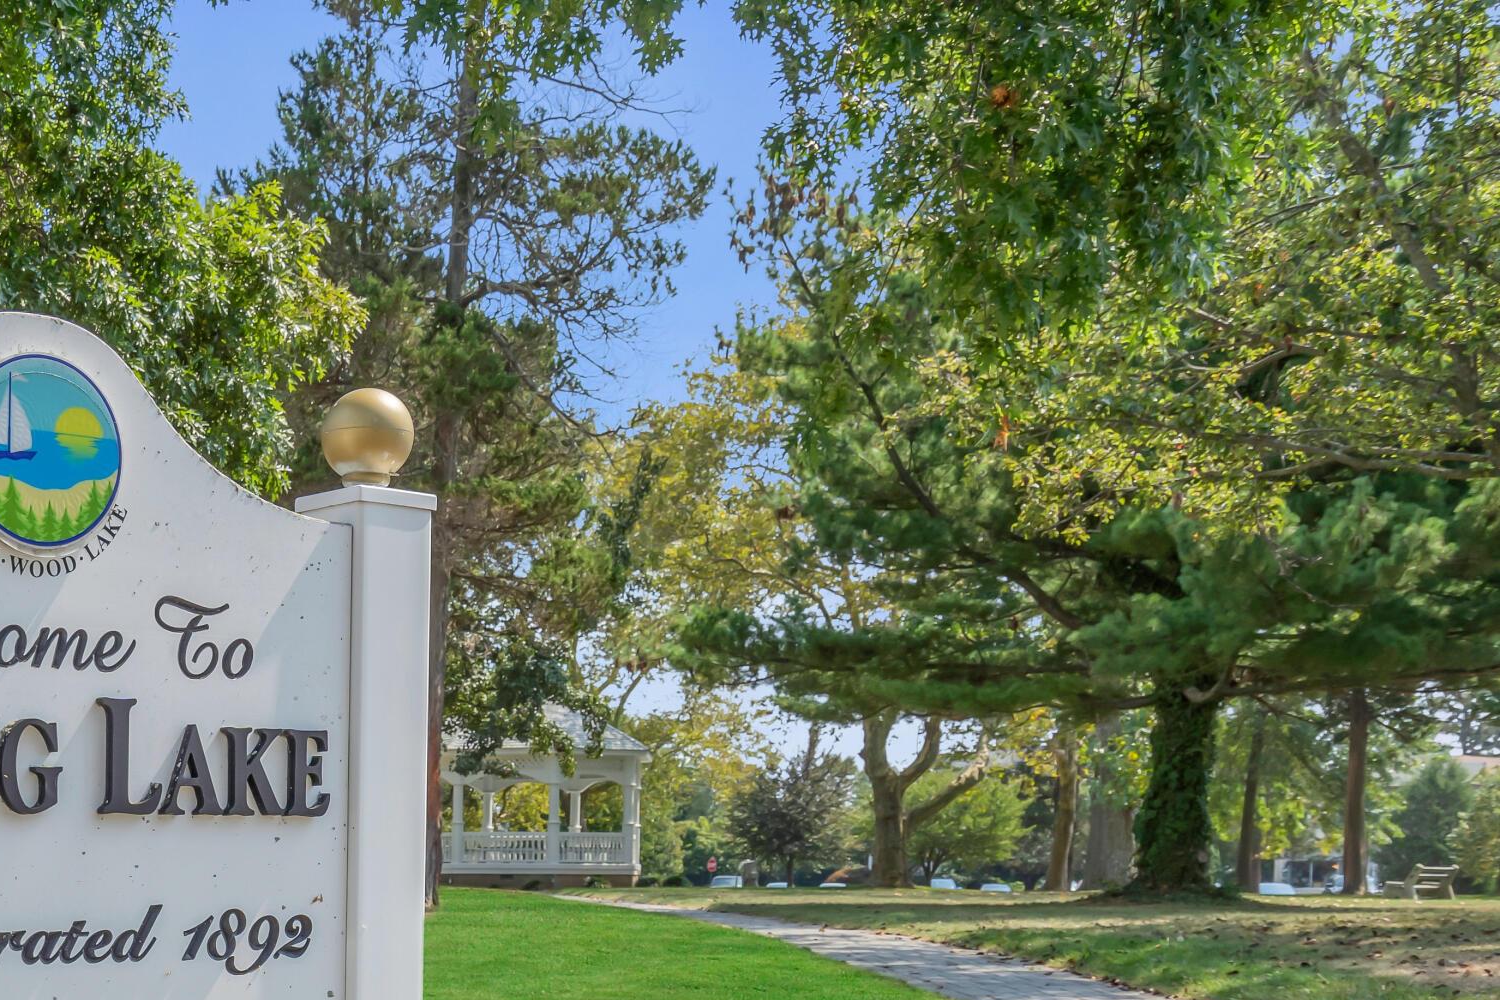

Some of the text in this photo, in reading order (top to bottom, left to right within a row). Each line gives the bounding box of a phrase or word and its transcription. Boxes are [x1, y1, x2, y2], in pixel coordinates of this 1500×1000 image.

[154, 594, 254, 680] To
[96, 696, 331, 818] LAKE
[181, 906, 314, 977] 1892
